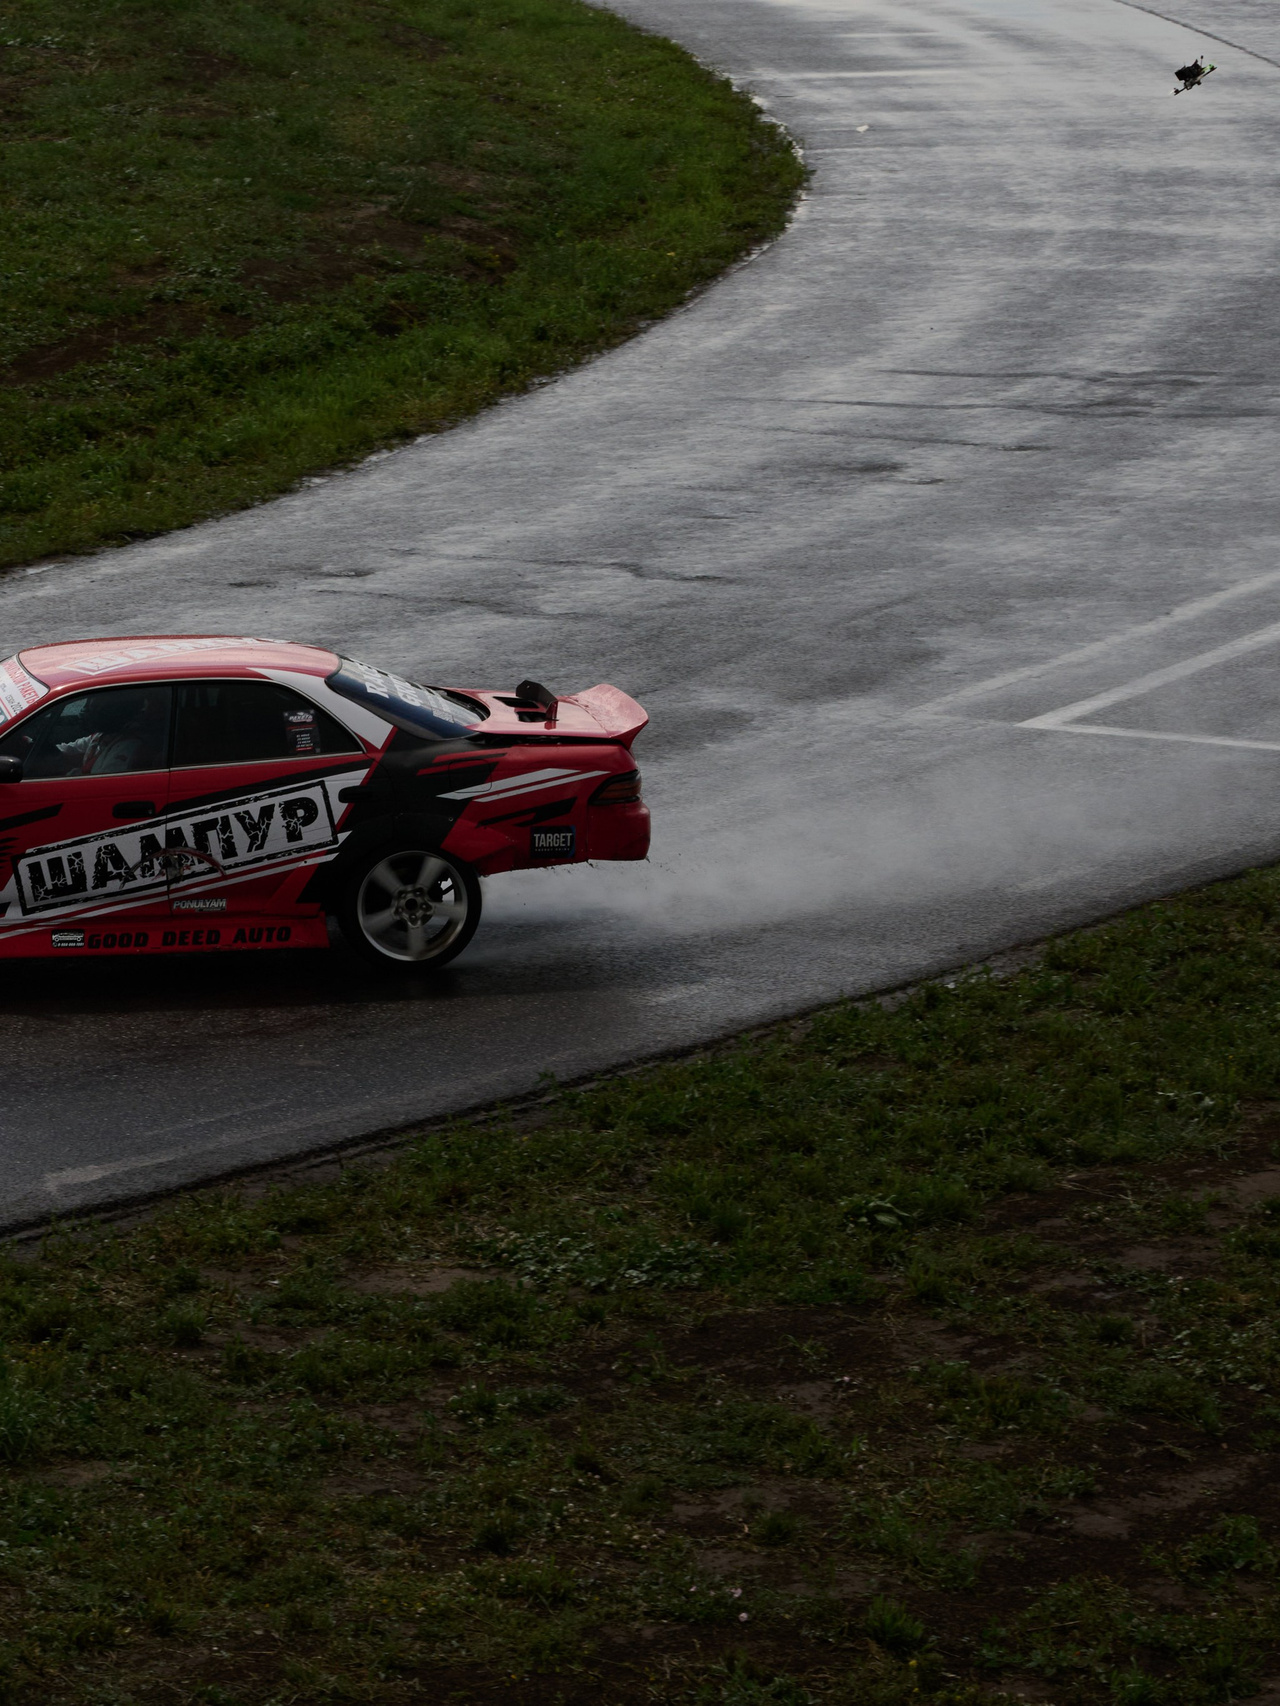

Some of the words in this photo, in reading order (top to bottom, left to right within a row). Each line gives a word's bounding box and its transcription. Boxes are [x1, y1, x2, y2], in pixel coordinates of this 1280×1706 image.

[26, 796, 320, 902] ШАМПУР
[533, 832, 573, 848] TARGET
[88, 932, 149, 949] GOOD
[162, 929, 221, 946] DEED
[232, 926, 292, 943] AUTO
